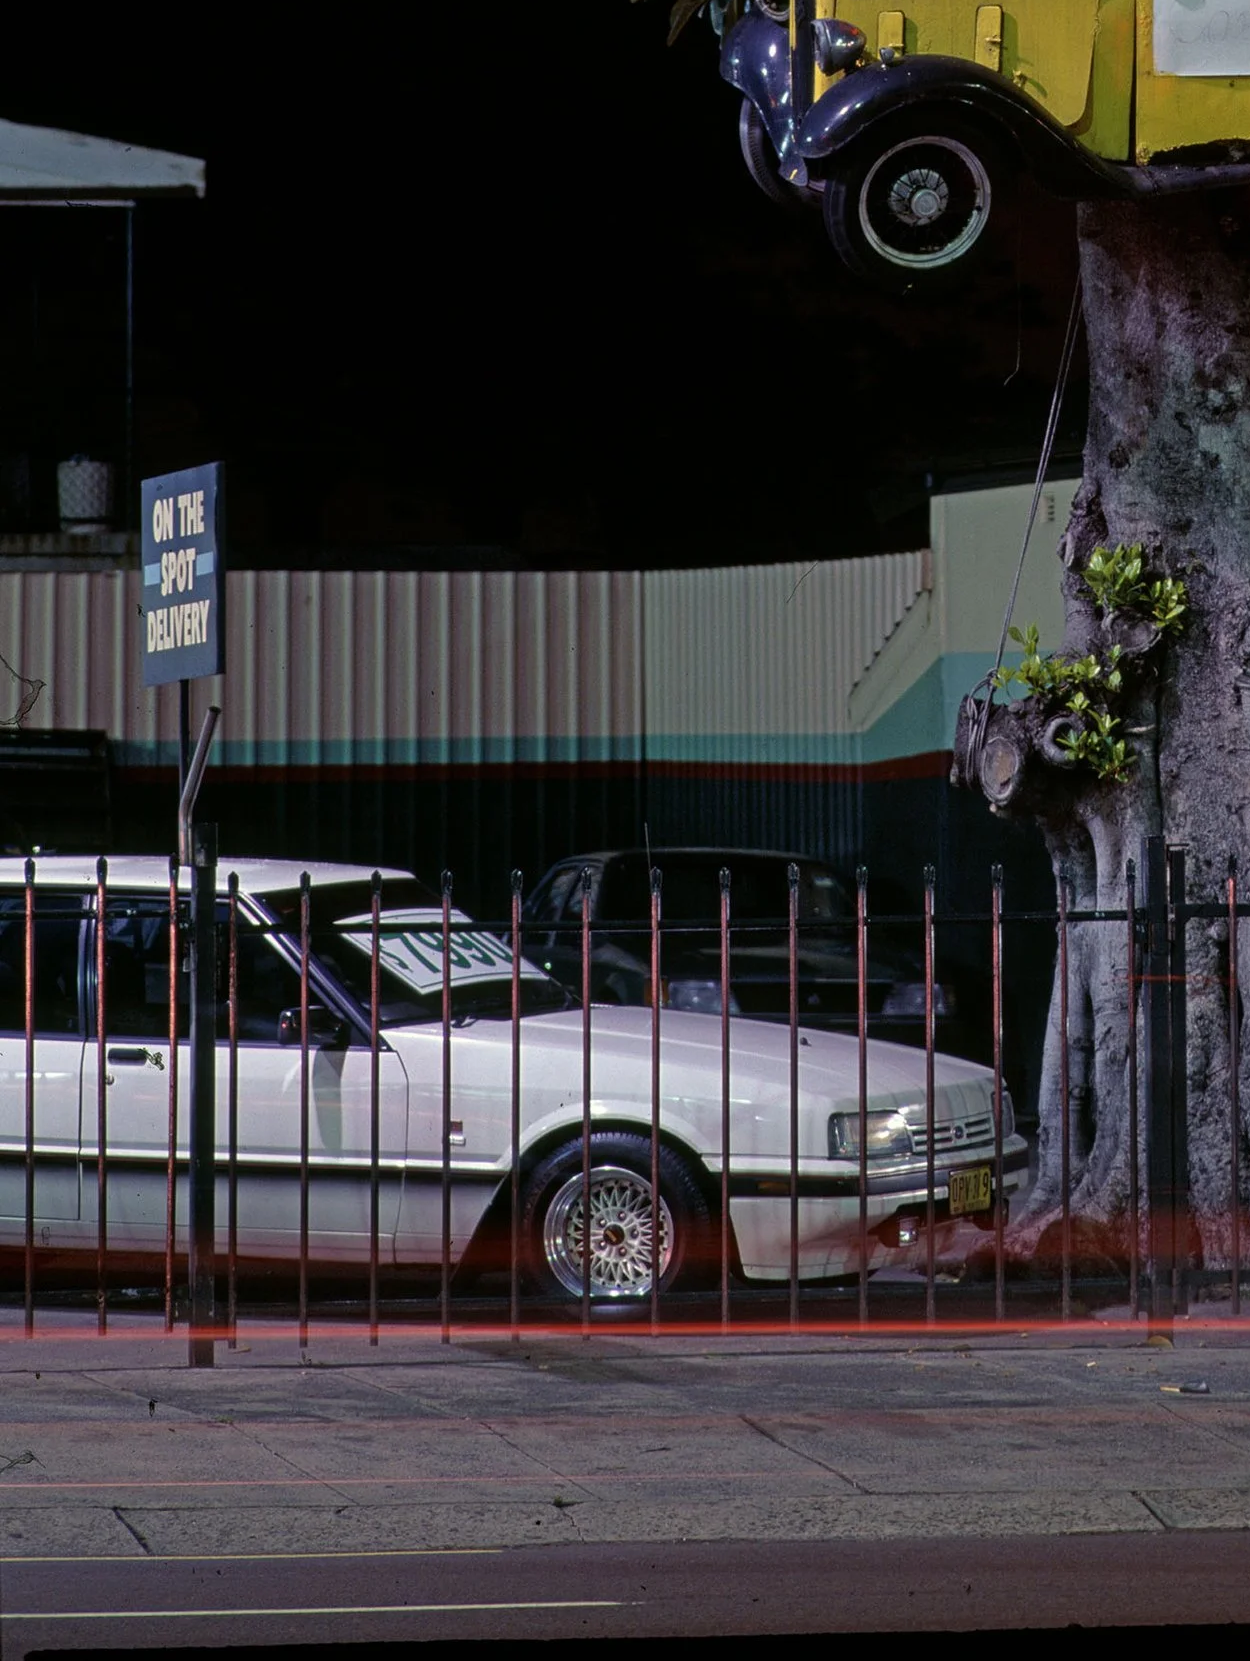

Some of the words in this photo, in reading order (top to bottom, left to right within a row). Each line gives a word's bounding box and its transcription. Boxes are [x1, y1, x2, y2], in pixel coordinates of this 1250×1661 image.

[153, 497, 174, 543] ON
[178, 490, 205, 537] THE
[161, 547, 196, 597] SPOT
[148, 599, 210, 653] DELIVERY
